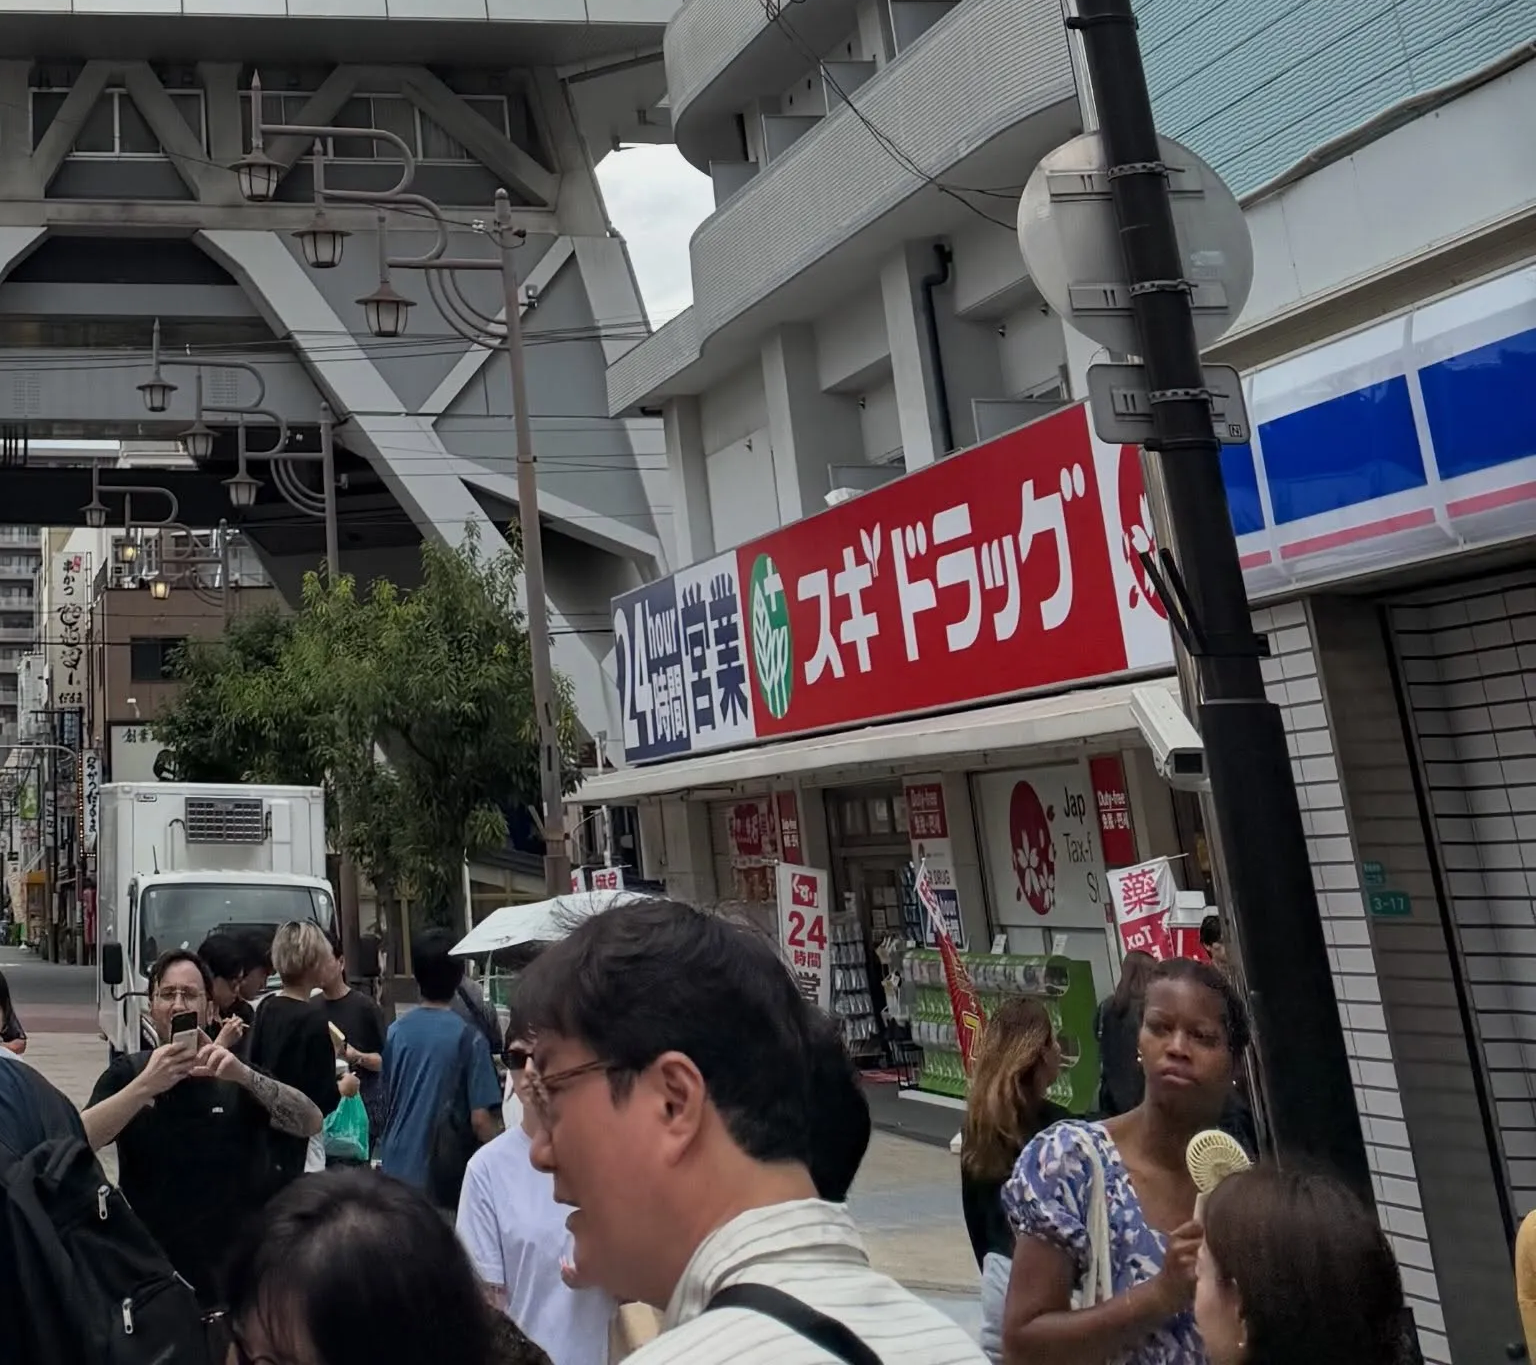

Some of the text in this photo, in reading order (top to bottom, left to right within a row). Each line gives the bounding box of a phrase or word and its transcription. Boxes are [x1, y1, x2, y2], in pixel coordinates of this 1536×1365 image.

[797, 462, 1086, 686] スギドラッグ
[614, 599, 678, 749] 24 hour
[652, 572, 749, 743] 時間 営業
[1097, 789, 1127, 809] Duty-free
[788, 910, 827, 951] 24
[793, 950, 822, 969] 時間
